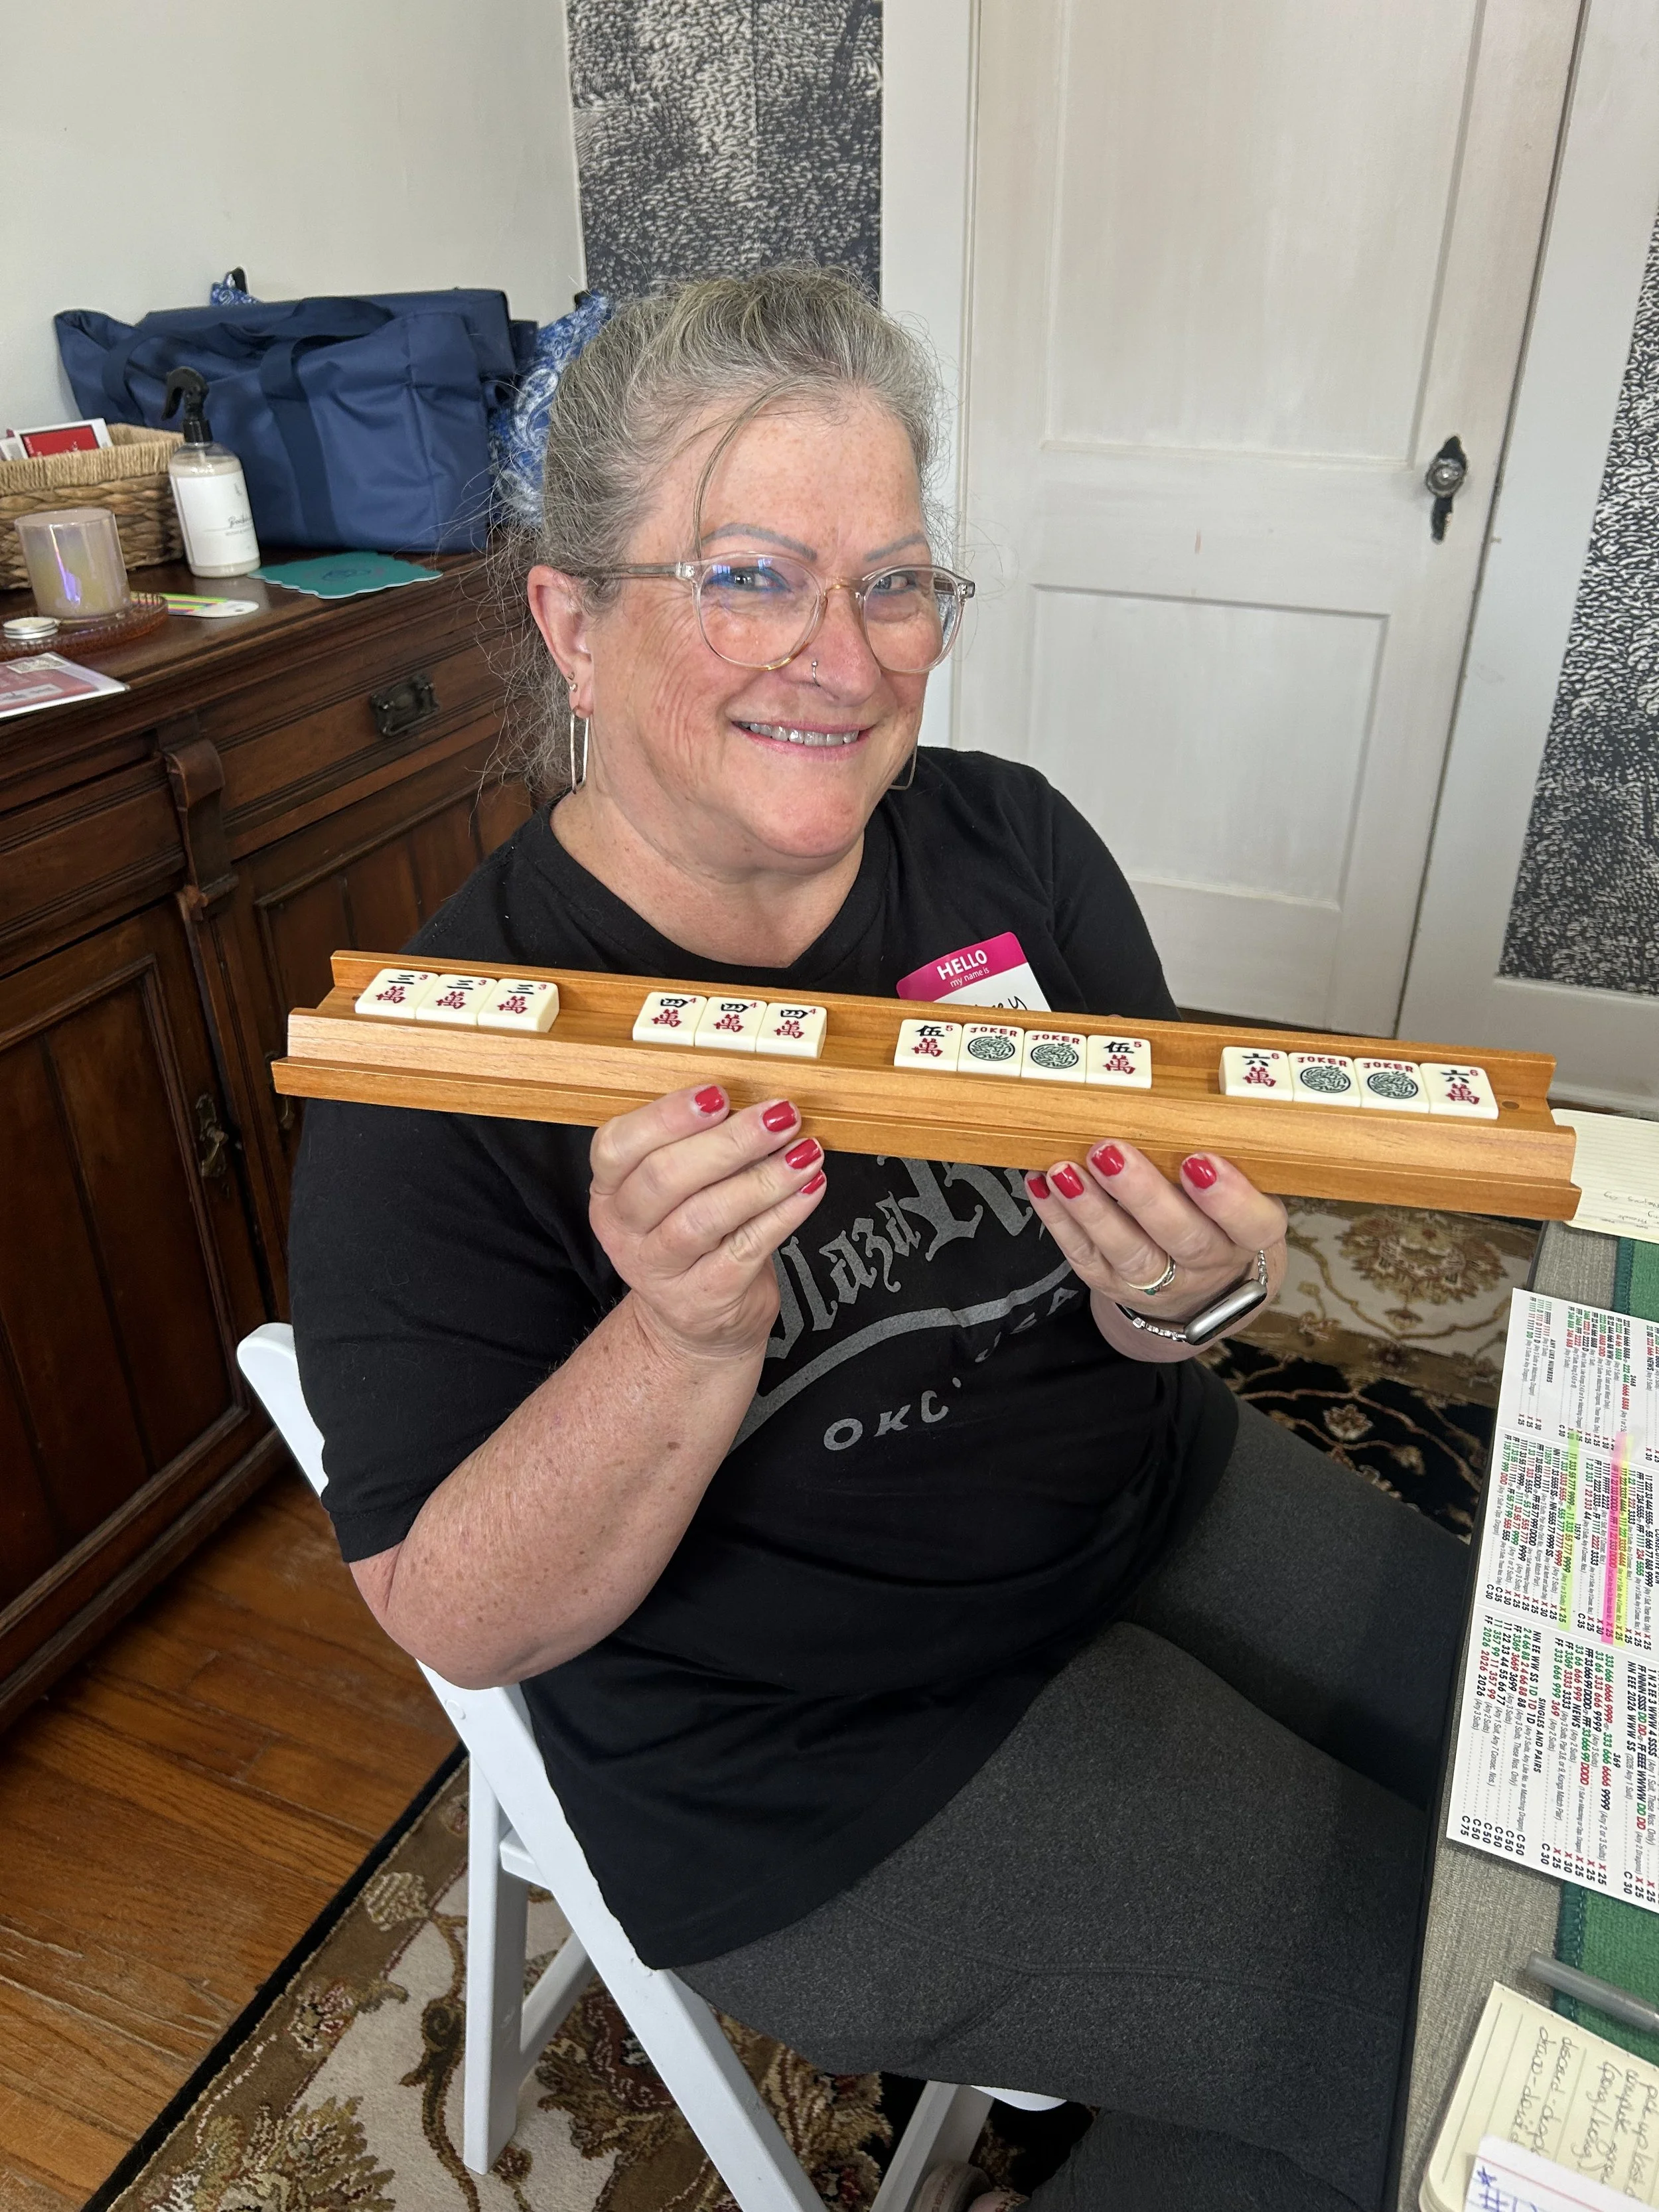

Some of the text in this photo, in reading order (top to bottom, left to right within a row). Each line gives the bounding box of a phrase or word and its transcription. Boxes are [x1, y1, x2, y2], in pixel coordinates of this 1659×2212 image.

[936, 950, 987, 980] HELLO
[950, 978, 962, 988] my
[964, 971, 983, 982] name
[969, 1026, 1017, 1037] JOKER
[1032, 1034, 1080, 1045] JOKER
[1297, 1056, 1347, 1067] JOKER
[1362, 1061, 1414, 1073] JOKER
[824, 1390, 949, 1451] OKC
[1484, 1615, 1492, 1624] FF
[1494, 1619, 1502, 1627] 11
[1513, 1624, 1522, 1633] FF
[1482, 1627, 1491, 1647] 2026
[1492, 1630, 1501, 1645] 357
[1502, 1633, 1511, 1643] 22
[1512, 1633, 1521, 1651] 3369
[1532, 1631, 1541, 1643] NN
[1555, 1637, 1563, 1647] FF
[1624, 1634, 1632, 1644] 25
[1501, 1645, 1510, 1655] 33
[1532, 1644, 1540, 1653] EE
[1565, 1641, 1573, 1649] FF
[1575, 1645, 1583, 1655] 33
[1491, 1647, 1500, 1657] 99
[1553, 1648, 1563, 1662] 333
[1595, 1651, 1603, 1660] 33
[1479, 1650, 1489, 1670] 2026
[1490, 1659, 1498, 1668] 11
[1500, 1657, 1508, 1667] 44
[1510, 1653, 1519, 1671] 3669
[1530, 1656, 1539, 1670] WW
[1564, 1651, 1573, 1668] 3369
[1574, 1656, 1583, 1666] 66
[1553, 1665, 1561, 1680] 666
[1595, 1662, 1603, 1672] 66
[1627, 1660, 1636, 1674] NN
[1488, 1670, 1497, 1686] 357
[1498, 1668, 1508, 1679] 55
[1530, 1672, 1538, 1682] SS
[1563, 1670, 1572, 1688] 3333
[1573, 1668, 1582, 1683] 666
[1477, 1674, 1486, 1696] 2026
[1497, 1681, 1506, 1692] 66
[1508, 1672, 1518, 1691] 3699
[1594, 1675, 1603, 1690] 333
[1627, 1675, 1636, 1689] EEE
[1486, 1688, 1495, 1699] 99
[1529, 1685, 1538, 1696] 1D
[1552, 1682, 1561, 1698] 999
[1573, 1686, 1582, 1701] 999
[1496, 1694, 1505, 1705] 77
[1505, 1692, 1514, 1704] (Any
[1561, 1690, 1571, 1709] 3333
[1593, 1692, 1602, 1708] 666
[1627, 1690, 1636, 1710] 2026
[1483, 1702, 1492, 1714] (Any
[1528, 1699, 1536, 1710] 1D
[1551, 1700, 1559, 1716] 369
[1526, 1713, 1536, 1724] 1D
[1537, 1698, 1546, 1728] SINGLES
[1571, 1704, 1581, 1728] NEWS
[1548, 1718, 1557, 1731] (Any
[1593, 1711, 1601, 1732] 9999
[1626, 1714, 1636, 1738] WWW
[1591, 1733, 1599, 1746] (Any
[1626, 1740, 1635, 1751] SS
[1533, 1749, 1542, 1773] PAIRS
[1624, 1769, 1633, 1781] Any
[1460, 1824, 1469, 1836] 75
[1471, 1827, 1480, 1839] 50
[1482, 1831, 1491, 1843] 50
[1493, 1835, 1502, 1847] 50
[1516, 1842, 1524, 1855] 50
[1540, 1852, 1549, 1864] 30
[1552, 1856, 1561, 1869] 25
[1563, 1860, 1572, 1873] 30
[1586, 1868, 1595, 1881] 25
[1623, 1881, 1632, 1894] 30
